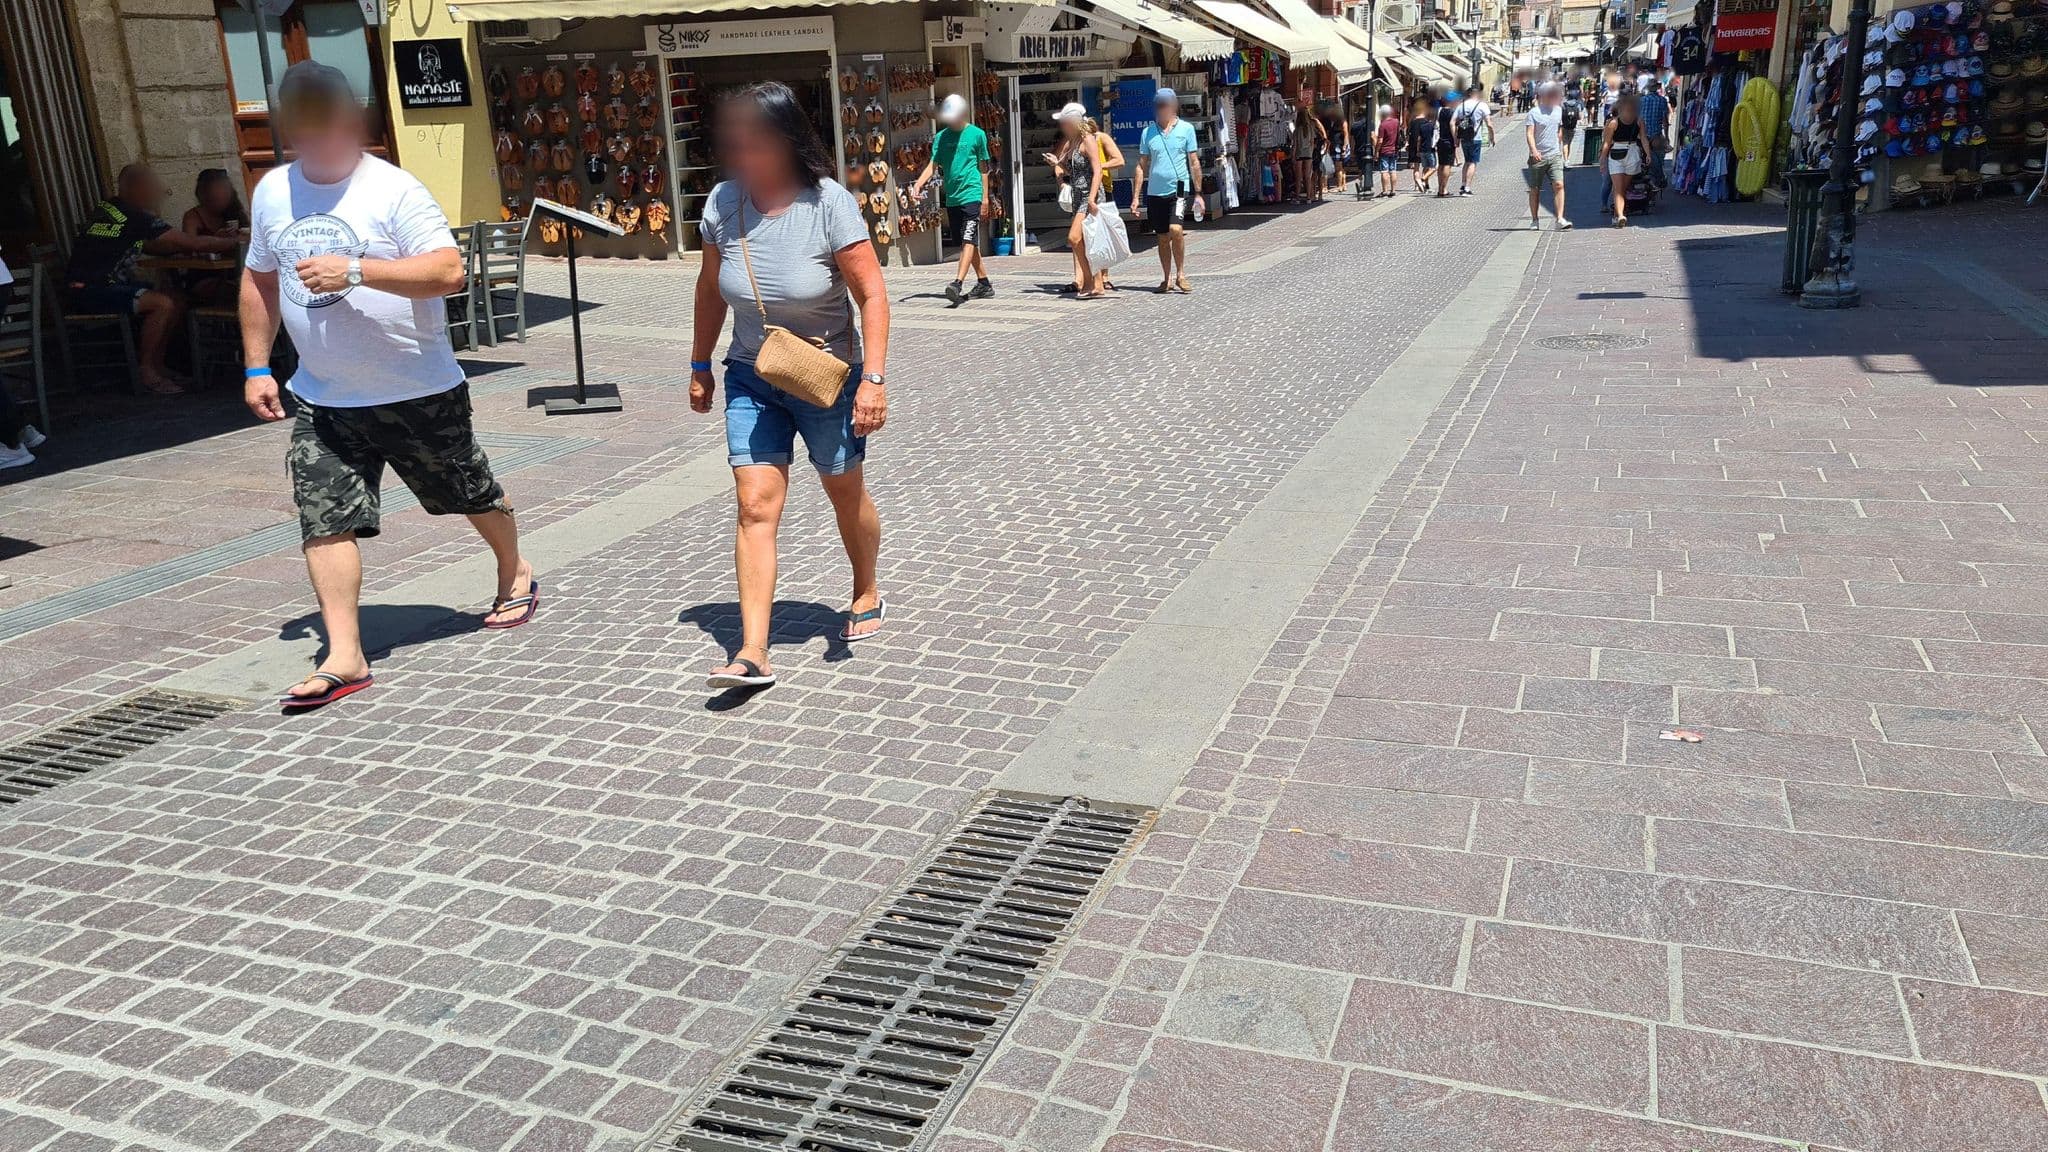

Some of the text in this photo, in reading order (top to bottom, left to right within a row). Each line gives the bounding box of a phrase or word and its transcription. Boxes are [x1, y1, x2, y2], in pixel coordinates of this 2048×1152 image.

[679, 29, 711, 44] NIKOS
[720, 27, 824, 39] HANDMADE LEATHER SANDALS
[1717, 27, 1773, 38] havaianas
[1019, 35, 1085, 58] ARIEL FISH SPA
[1682, 45, 1699, 61] 34
[404, 80, 463, 95] NAMASTE
[292, 227, 341, 238] VINTAGE
